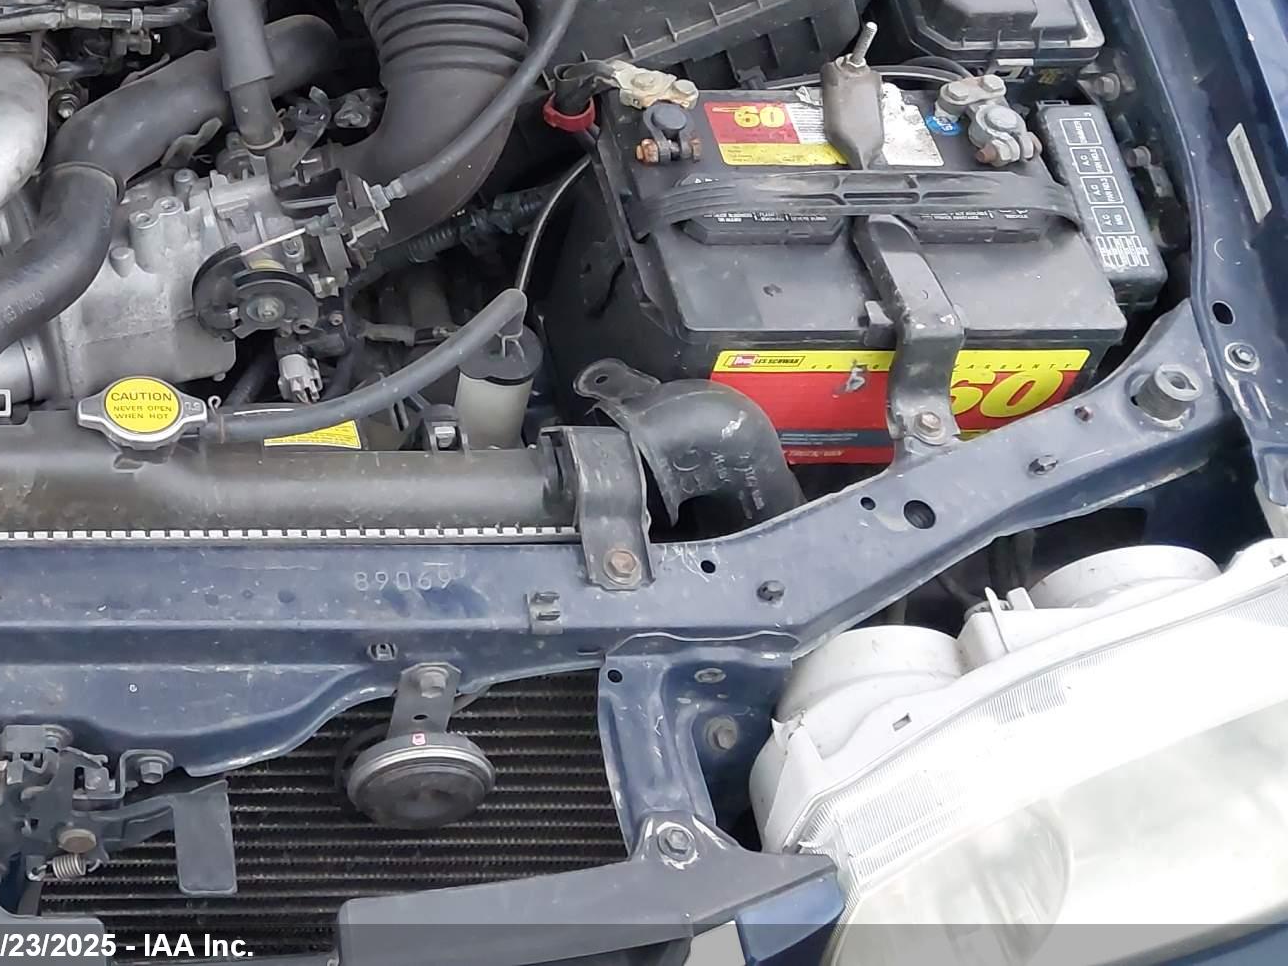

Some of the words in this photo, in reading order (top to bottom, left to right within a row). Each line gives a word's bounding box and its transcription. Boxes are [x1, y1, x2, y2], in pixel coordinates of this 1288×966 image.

[734, 105, 786, 128] 60
[111, 392, 172, 402] CAUTION
[354, 570, 453, 592] 89069
